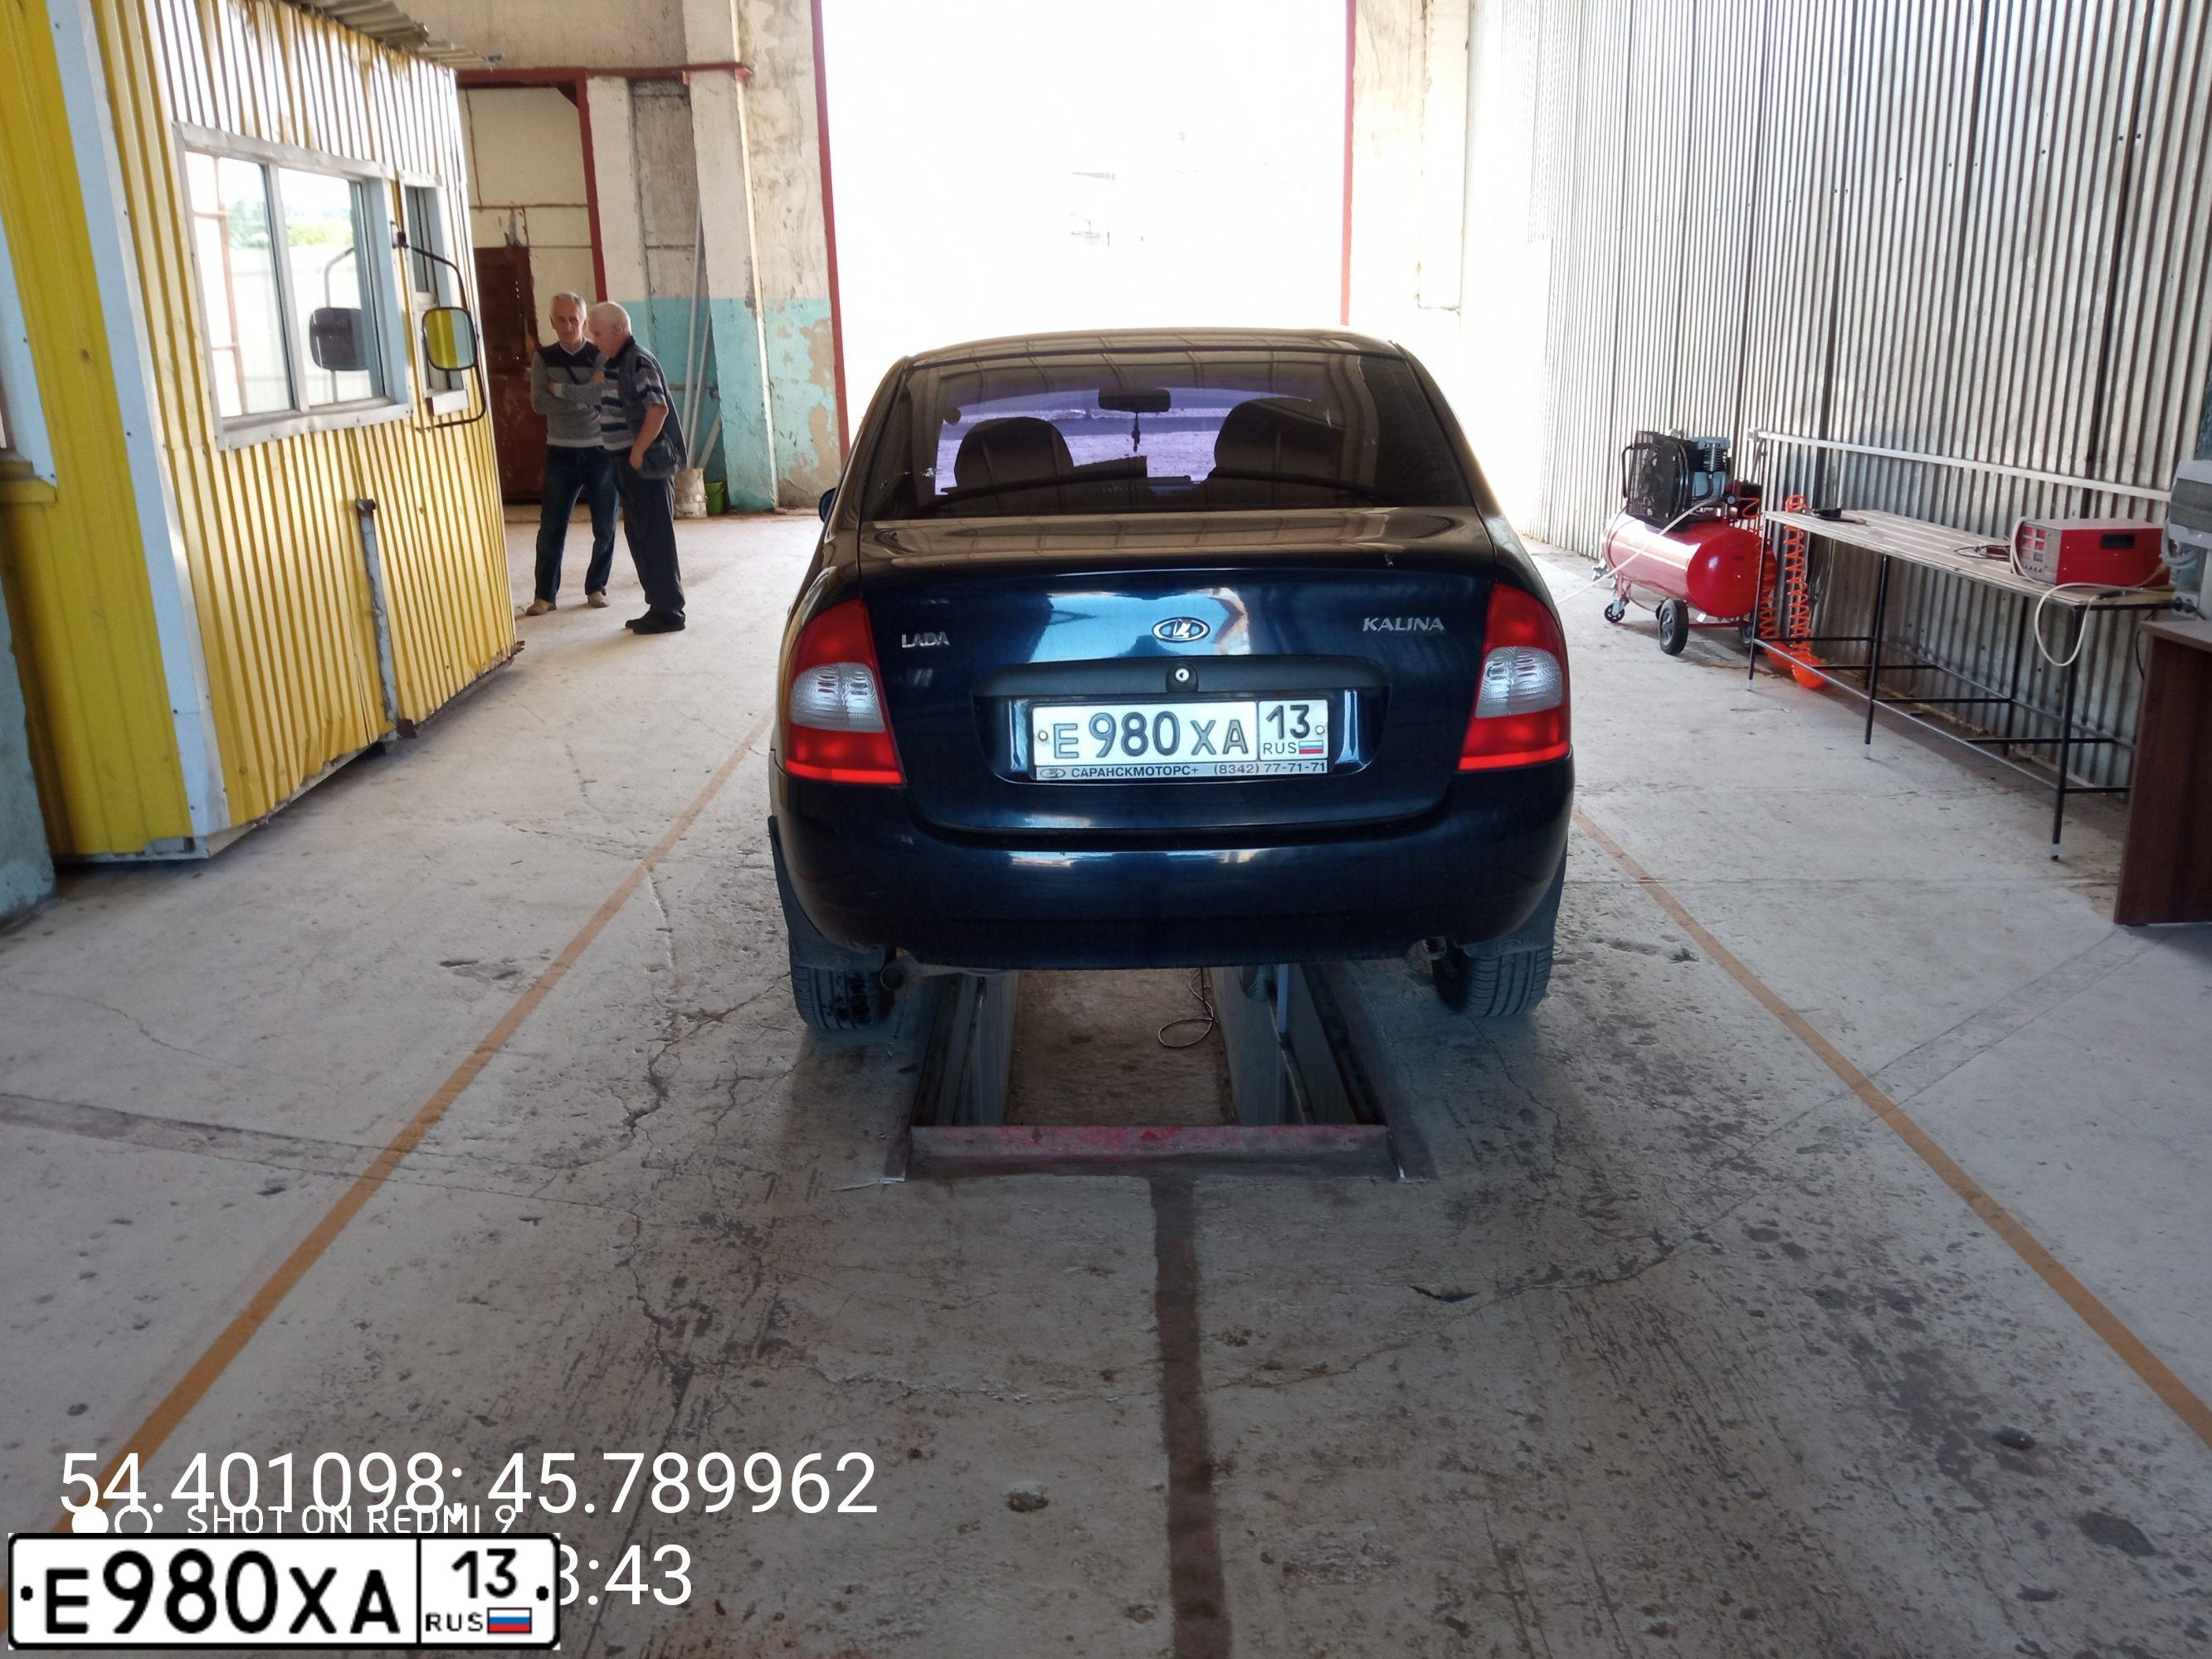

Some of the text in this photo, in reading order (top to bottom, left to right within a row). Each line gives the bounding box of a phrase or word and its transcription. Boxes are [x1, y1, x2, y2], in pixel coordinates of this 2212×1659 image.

[1362, 617, 1445, 631] KALINA
[901, 631, 950, 648] LADA
[1266, 704, 1310, 740] 13
[1263, 742, 1298, 755] RUS
[1214, 763, 1259, 776] (8342)
[1264, 761, 1325, 773] 77-71-71
